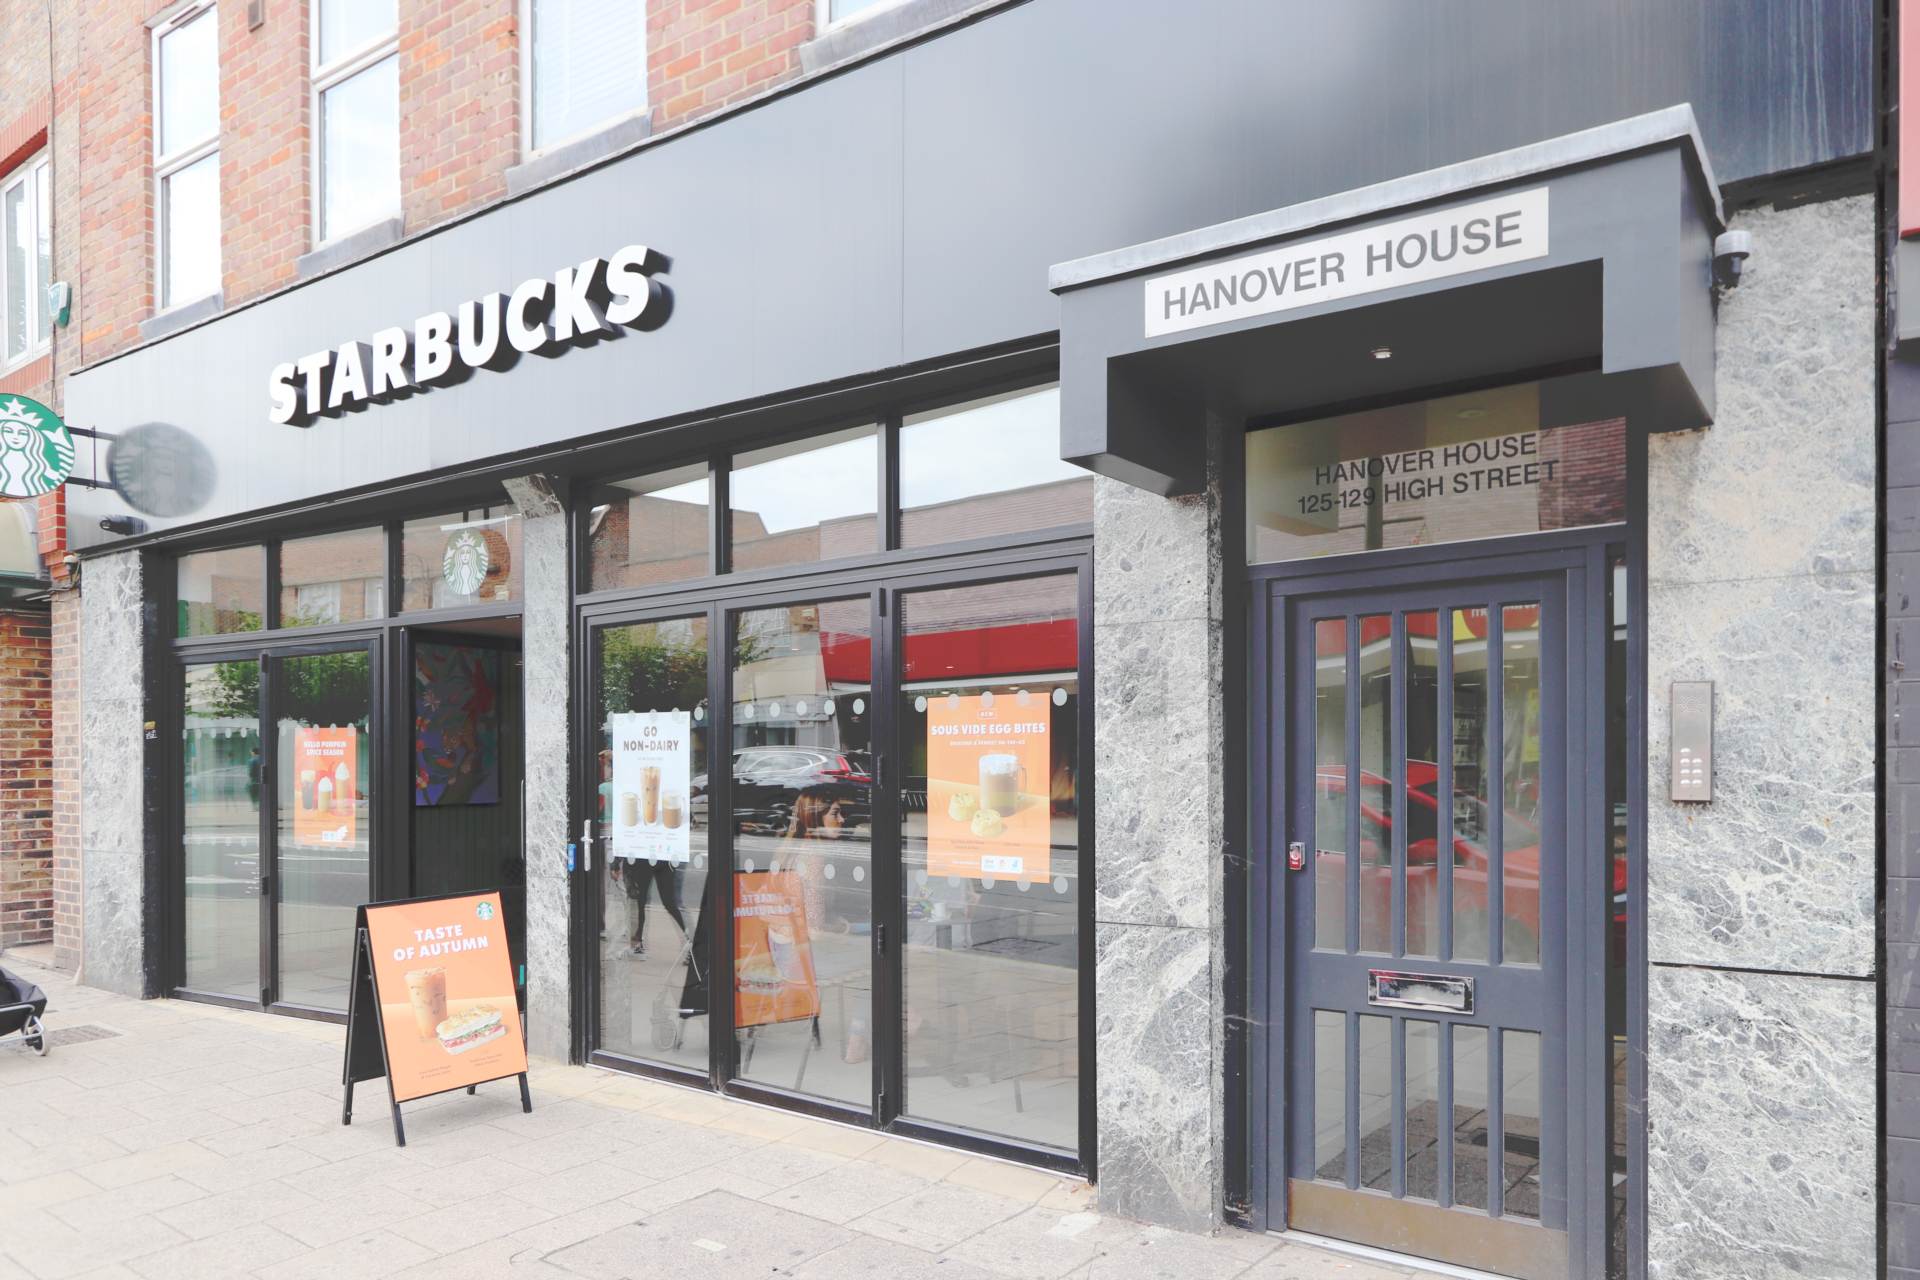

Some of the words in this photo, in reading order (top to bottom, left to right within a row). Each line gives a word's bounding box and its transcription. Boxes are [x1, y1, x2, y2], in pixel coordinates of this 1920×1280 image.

[1164, 251, 1345, 320] HANOVER
[1366, 210, 1522, 277] HOUSE
[269, 244, 650, 424] STARBUCKS
[1315, 450, 1434, 486] HANOVER
[1443, 433, 1537, 467] HOUSE
[1298, 487, 1376, 515] 125-129
[1384, 476, 1444, 504] HIGH
[1452, 460, 1560, 494] STREET
[643, 726, 658, 737] GO
[931, 725, 959, 735] SOUS
[961, 724, 987, 735] VIDE
[989, 724, 1012, 734] EGG
[1014, 722, 1046, 734] BITES
[623, 740, 679, 751] NON-DAIRY
[415, 925, 463, 941] TASTE
[394, 947, 415, 960] OF
[420, 936, 488, 957] AUTUMN
